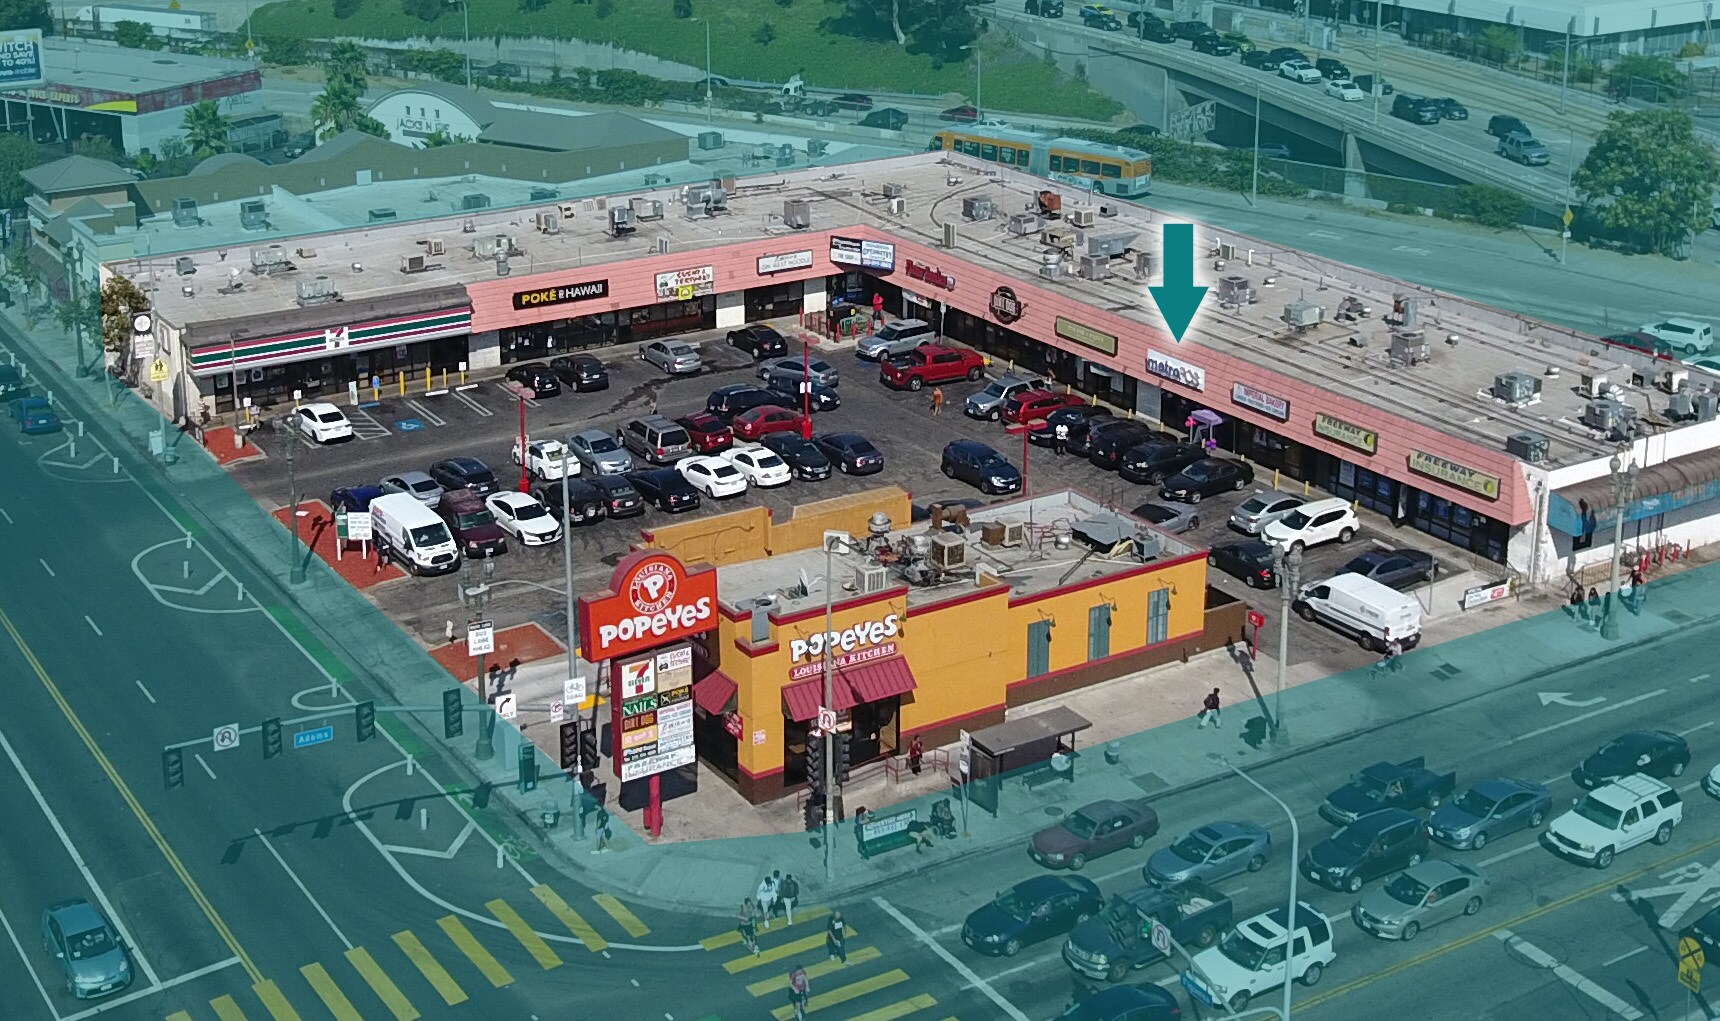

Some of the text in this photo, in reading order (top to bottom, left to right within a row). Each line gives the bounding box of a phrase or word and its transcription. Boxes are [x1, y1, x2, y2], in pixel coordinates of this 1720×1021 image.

[2, 59, 14, 67] TO
[565, 283, 603, 299] HAWAII
[1412, 460, 1481, 489] INSURANCE
[1416, 452, 1476, 478] FREEWAY
[641, 574, 665, 600] P
[599, 596, 711, 649] POPEYES
[790, 614, 898, 663] POPEYES
[848, 643, 895, 664] KITCHEN
[622, 699, 657, 717] NAILS
[298, 731, 329, 744] Adams
